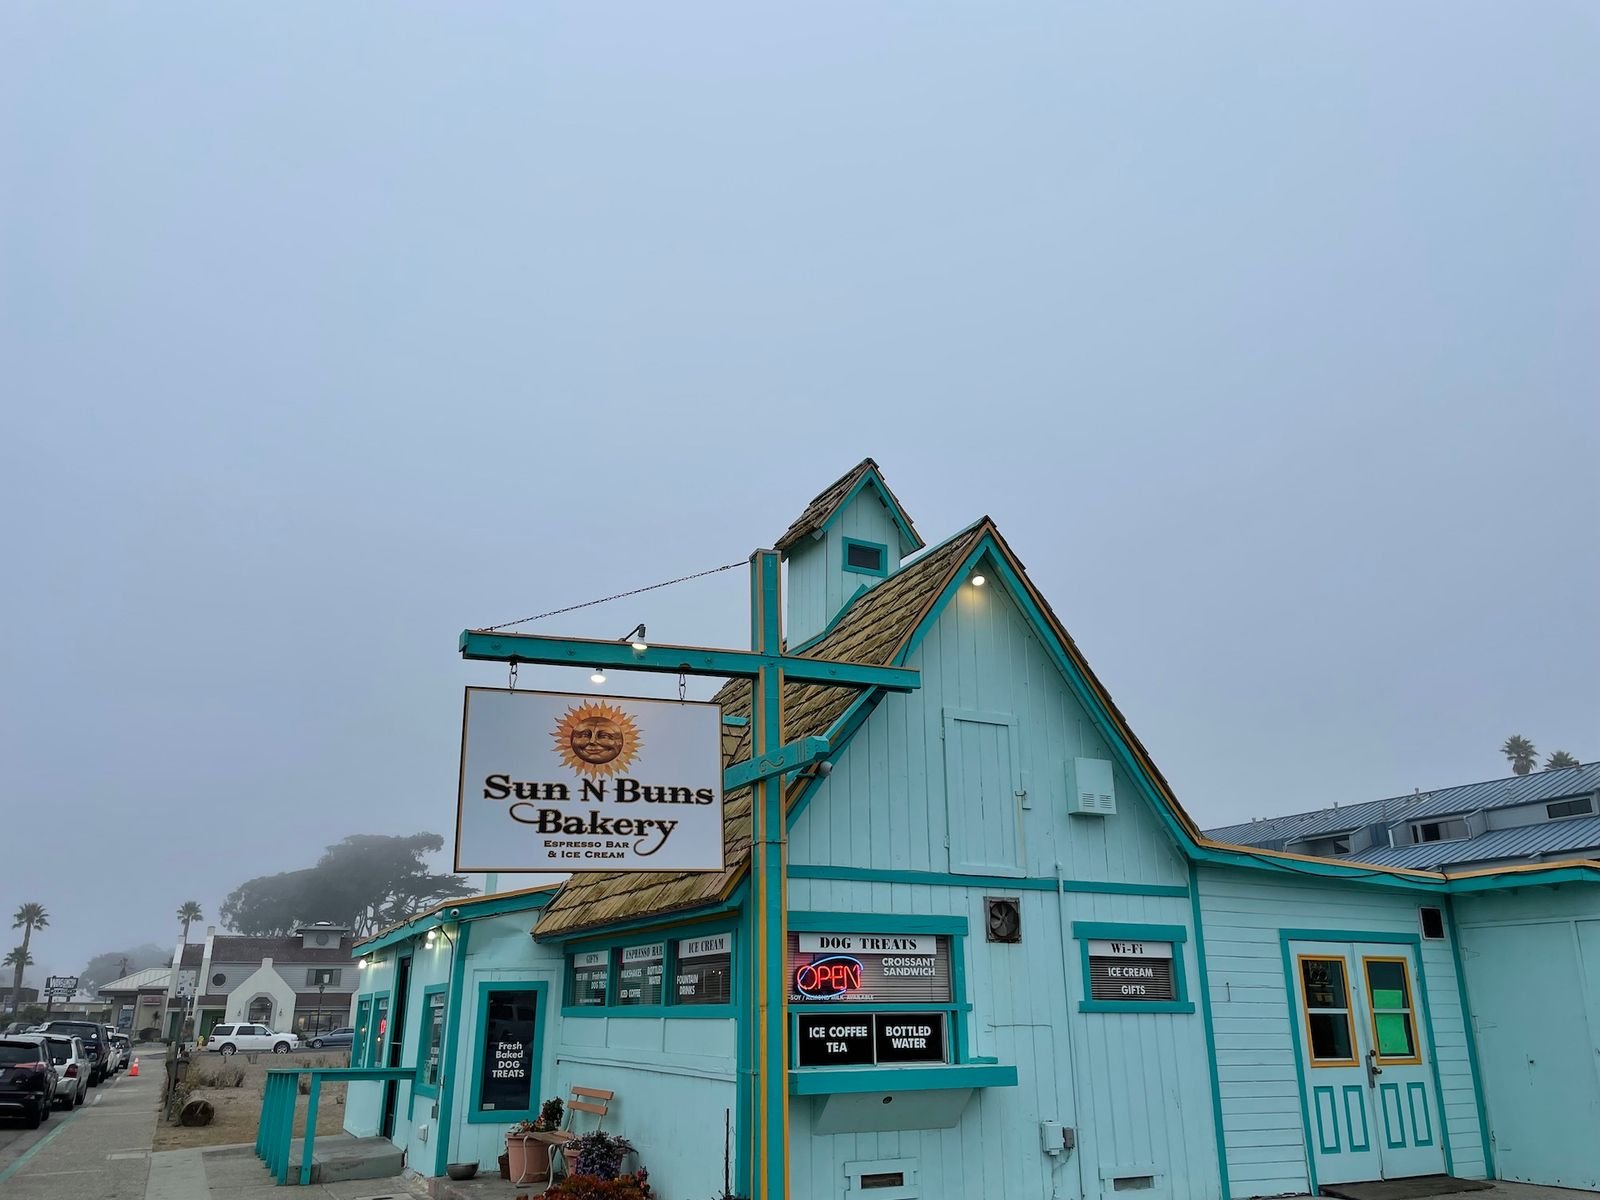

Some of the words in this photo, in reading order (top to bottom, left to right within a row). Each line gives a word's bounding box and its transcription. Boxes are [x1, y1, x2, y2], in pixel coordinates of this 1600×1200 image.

[483, 774, 570, 801] Sun
[578, 778, 610, 802] N
[614, 778, 715, 805] Buns
[509, 802, 678, 856] Bakery
[544, 840, 601, 849] ESPRESSO
[605, 840, 630, 849] BAR
[547, 850, 557, 859] &
[561, 851, 581, 859] ICE
[585, 851, 625, 859] CREAM
[688, 941, 699, 954] ICE
[701, 938, 724, 952] CREAM
[819, 937, 851, 949] DOG
[859, 938, 917, 951] TREATS
[1111, 942, 1144, 954] Wi-Fi
[625, 947, 650, 960] ESPRESSO
[882, 957, 935, 967] CROISSANT
[797, 964, 861, 990] OPEN
[883, 967, 936, 976] SANDWICH
[1108, 967, 1121, 977] ICE
[1123, 967, 1154, 977] CREAM
[676, 974, 698, 985] FOUNTAIN
[679, 985, 696, 995] DRINKS
[1121, 985, 1146, 995] GIFTS
[809, 1027, 826, 1038] ICE
[829, 1026, 867, 1038] COFFEE
[885, 1026, 931, 1037] BOTTLED
[498, 1041, 522, 1050] Fresh
[826, 1042, 848, 1053] TEA
[891, 1038, 926, 1049] WATER
[495, 1050, 524, 1059] Baked
[498, 1060, 520, 1069] DOG
[492, 1069, 525, 1078] TREATS
